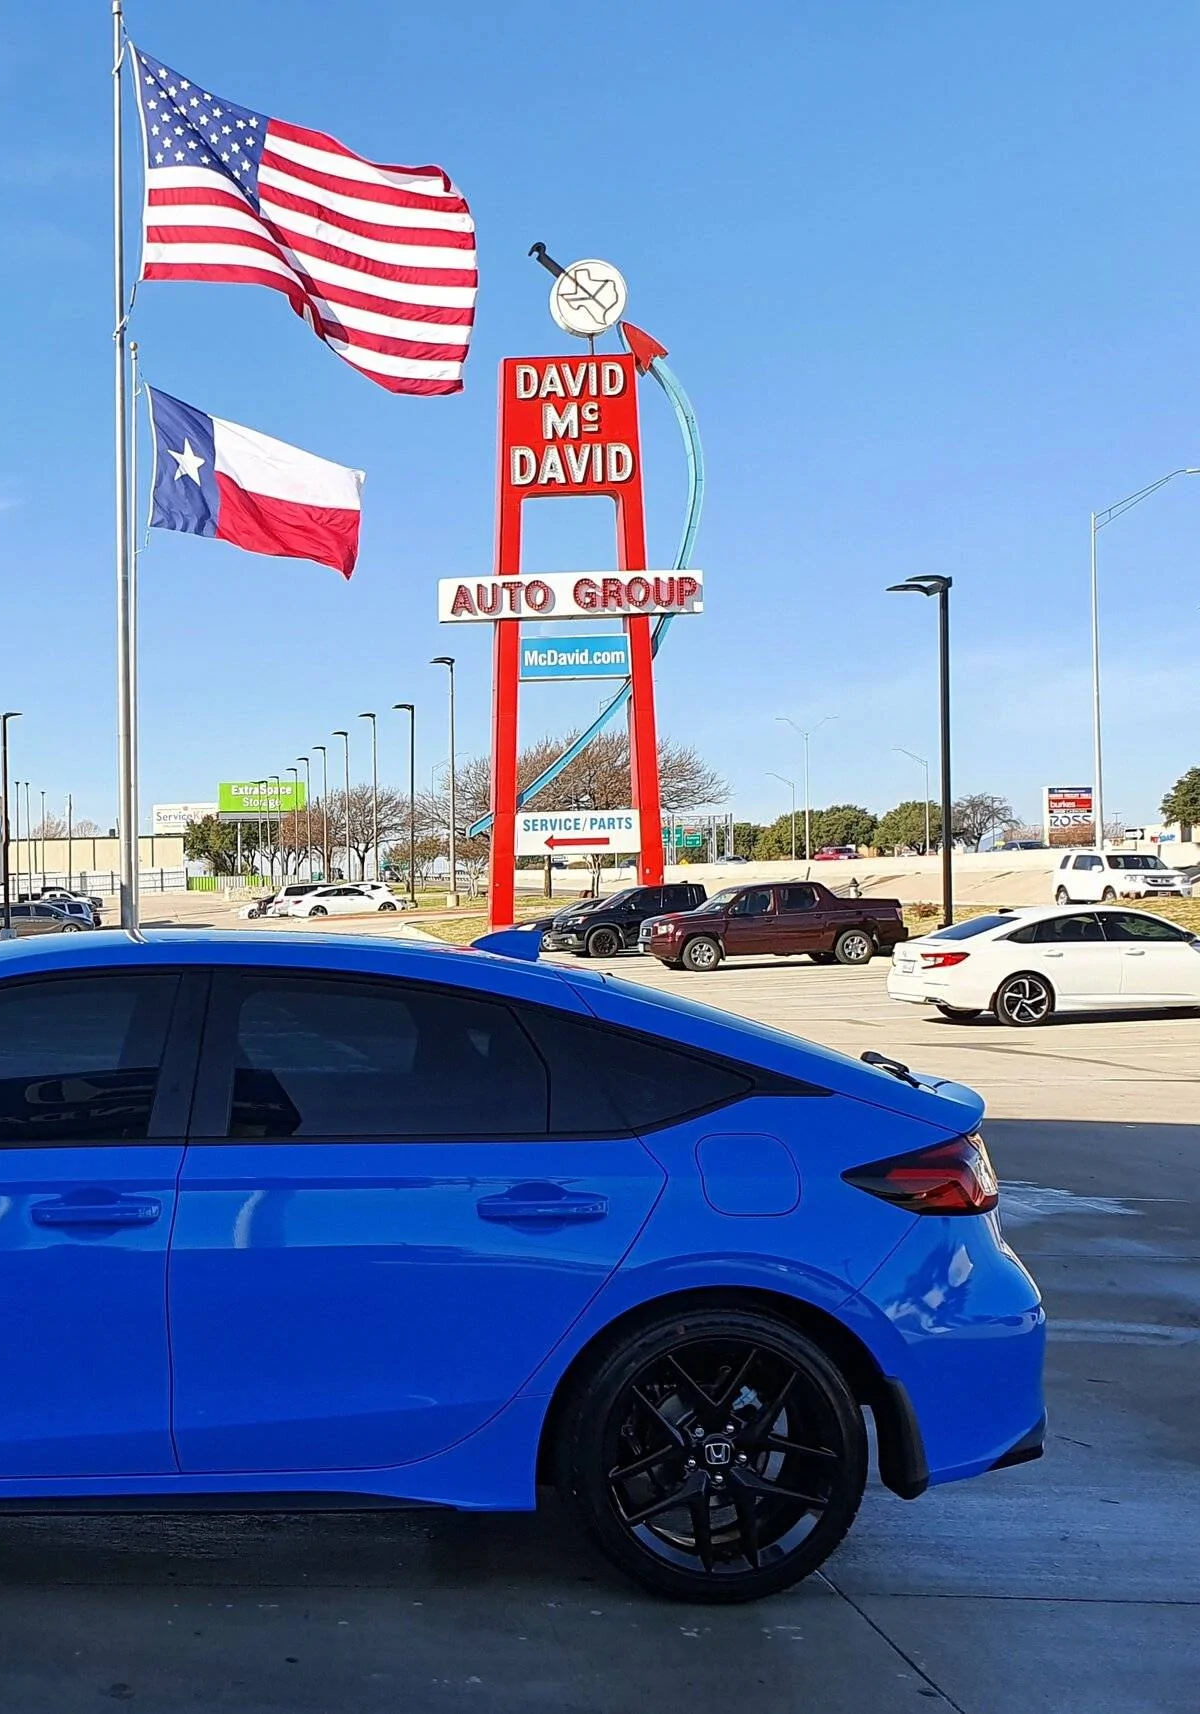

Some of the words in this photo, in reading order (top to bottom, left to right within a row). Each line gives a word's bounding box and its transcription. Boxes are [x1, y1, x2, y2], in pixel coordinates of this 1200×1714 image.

[515, 362, 625, 399] DAVID
[542, 402, 599, 440] Mc
[511, 443, 633, 486] DAVID
[451, 580, 552, 614] AUTO
[573, 576, 699, 610] GROUP
[524, 648, 626, 667] McDavid.com
[243, 797, 283, 810] Storage
[523, 817, 633, 832] SERVICE/PARTS
[1049, 815, 1091, 826] ROSS
